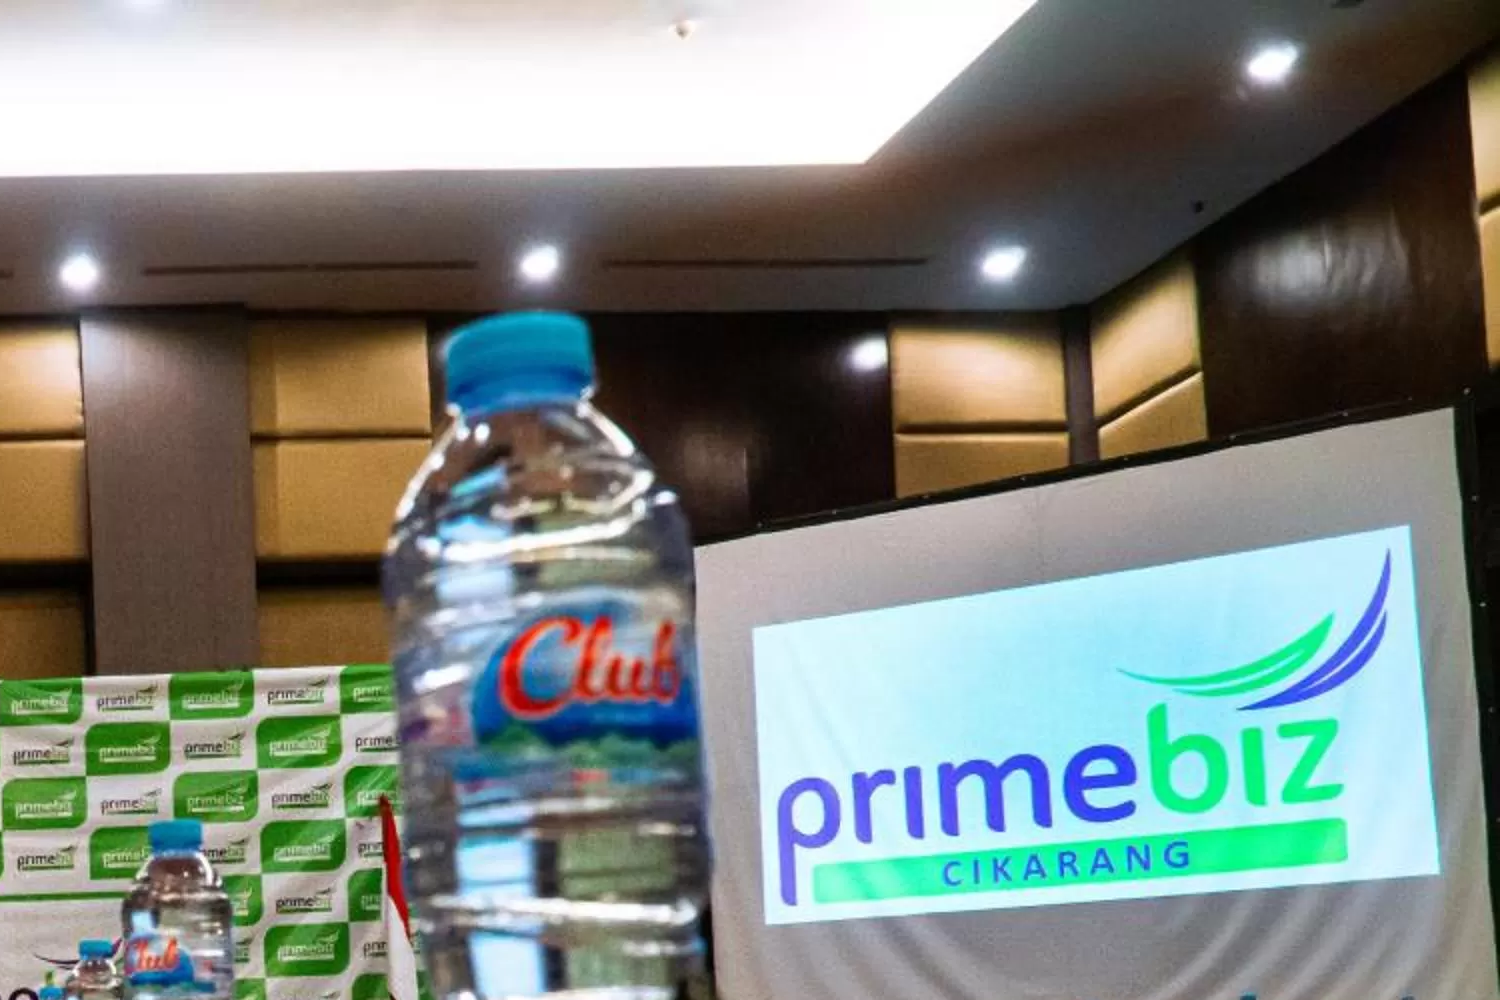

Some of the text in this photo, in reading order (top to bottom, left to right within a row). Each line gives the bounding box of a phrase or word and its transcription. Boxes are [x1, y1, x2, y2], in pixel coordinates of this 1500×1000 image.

[499, 615, 681, 720] Club
[777, 702, 1346, 906] primebiz
[942, 840, 1190, 888] CIKARANG
